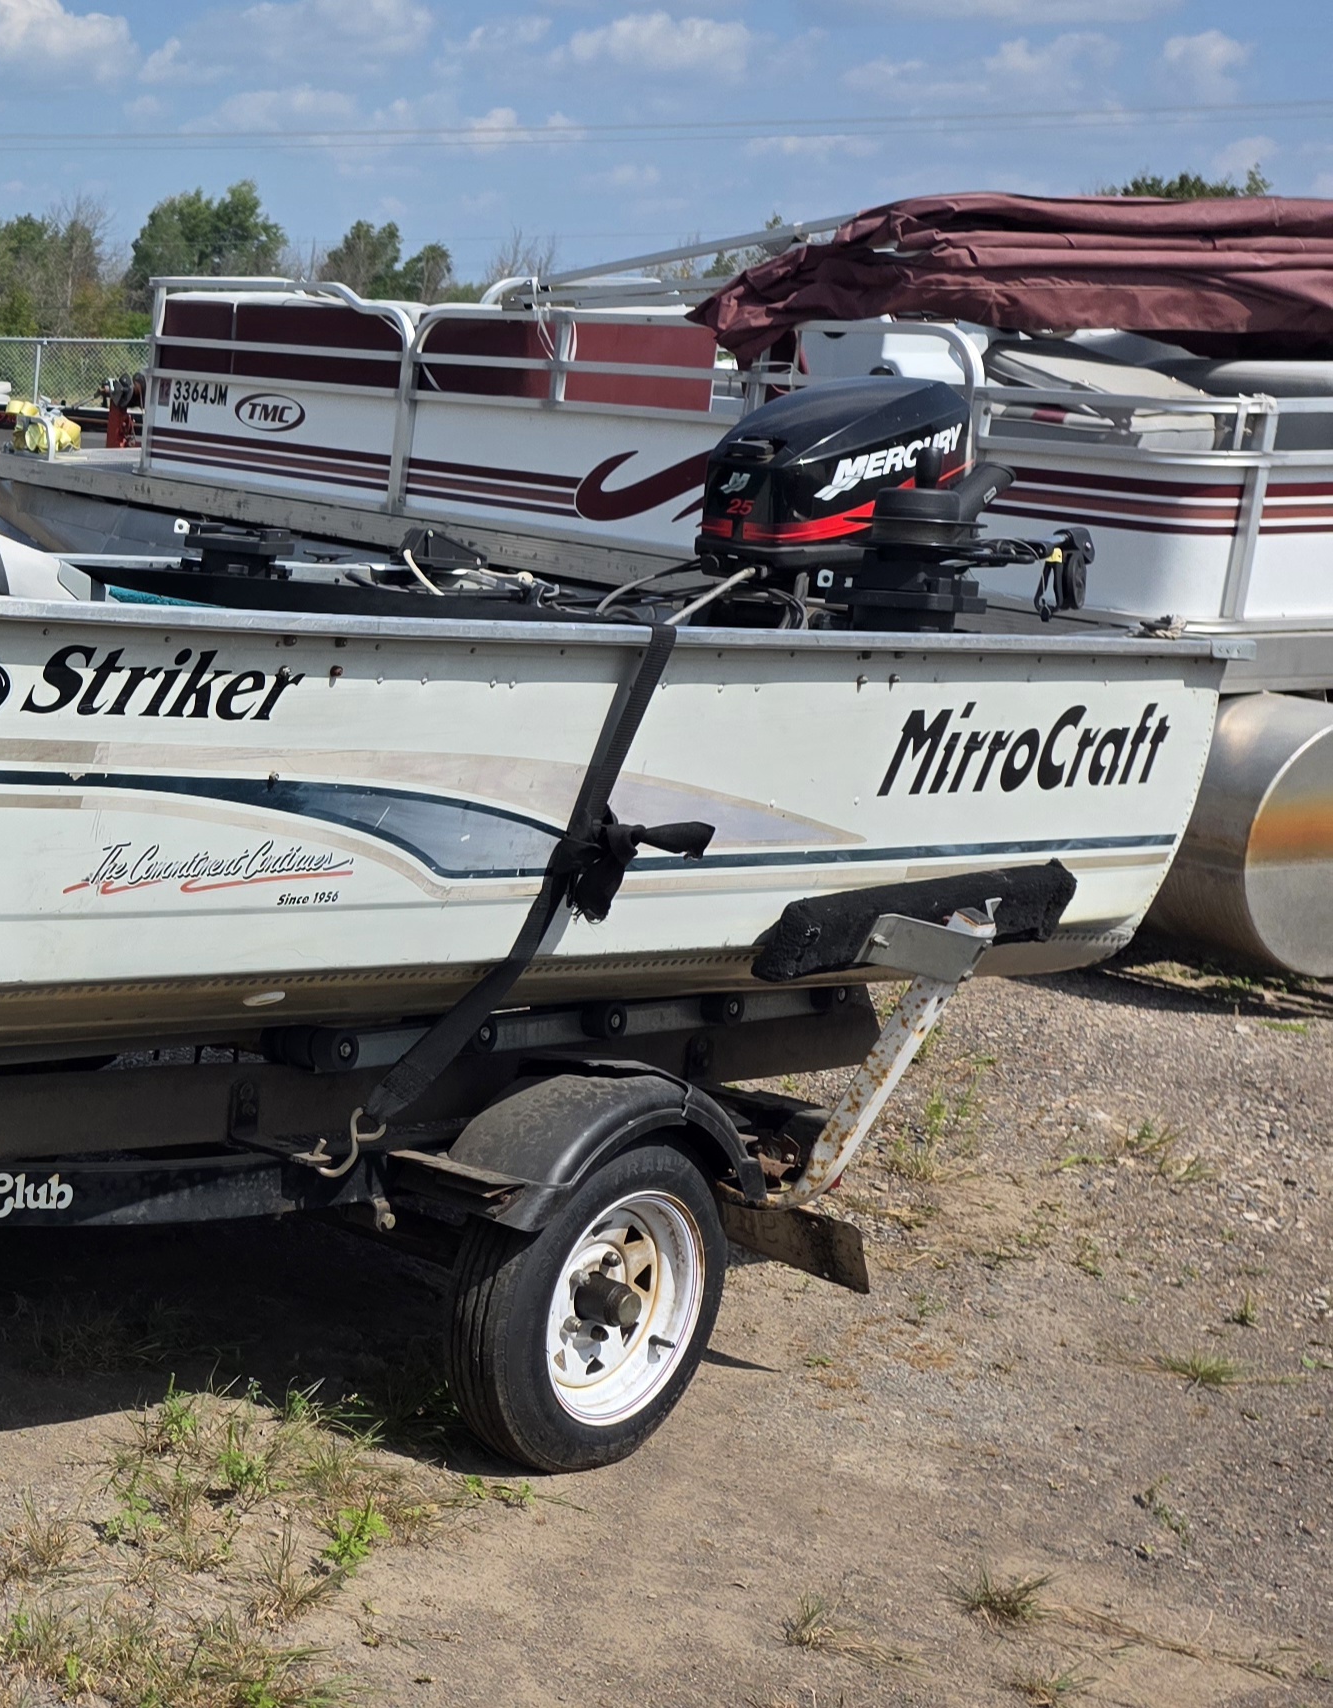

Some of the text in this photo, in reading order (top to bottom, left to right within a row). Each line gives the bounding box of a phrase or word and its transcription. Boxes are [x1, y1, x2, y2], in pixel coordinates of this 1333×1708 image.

[173, 380, 229, 406] 3364JM
[171, 401, 190, 423] MN
[248, 402, 293, 423] TMC
[726, 499, 755, 516] 25
[20, 645, 306, 721] Striker
[876, 701, 1171, 797] MirroCraft
[90, 839, 354, 884] The Commitment Continues
[276, 890, 340, 906] Since 1956
